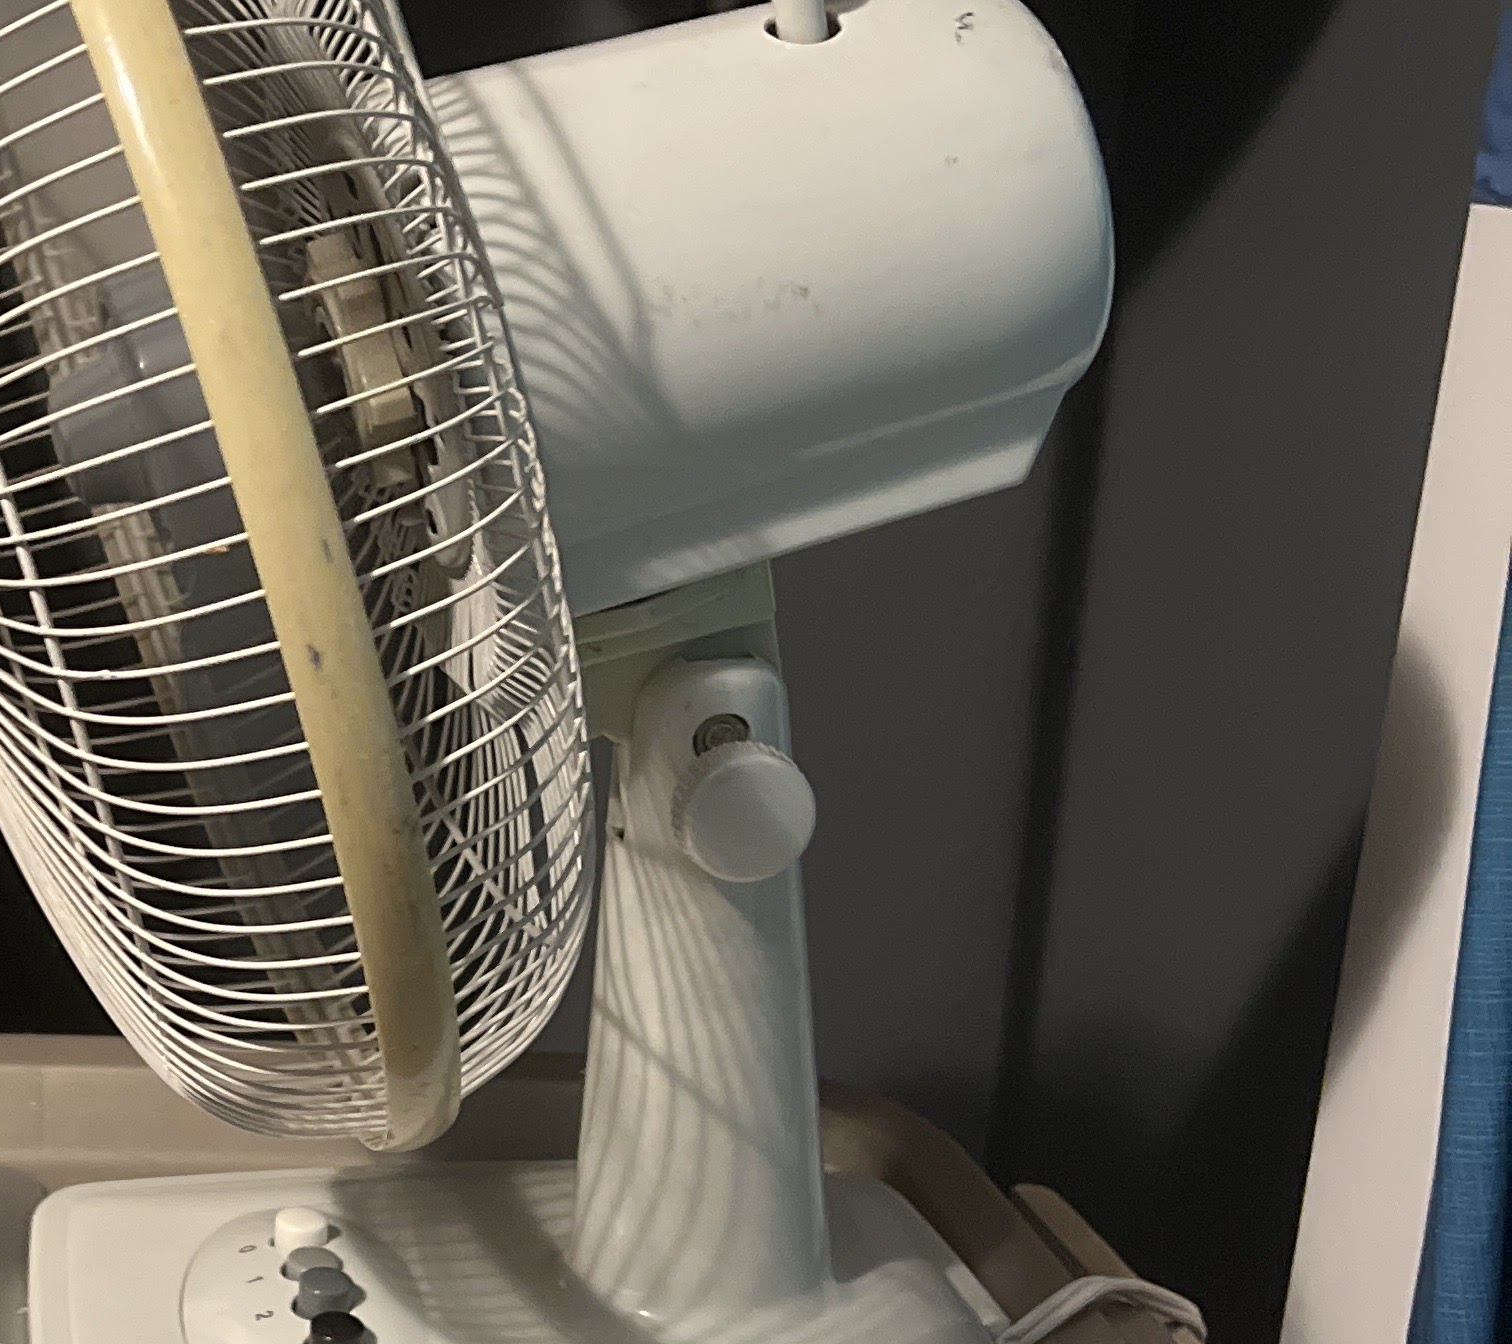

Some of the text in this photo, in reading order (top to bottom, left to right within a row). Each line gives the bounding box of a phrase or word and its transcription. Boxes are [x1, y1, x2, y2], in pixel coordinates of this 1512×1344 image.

[238, 1244, 257, 1254] 0
[246, 1275, 264, 1284] 1
[255, 1310, 274, 1321] 2
